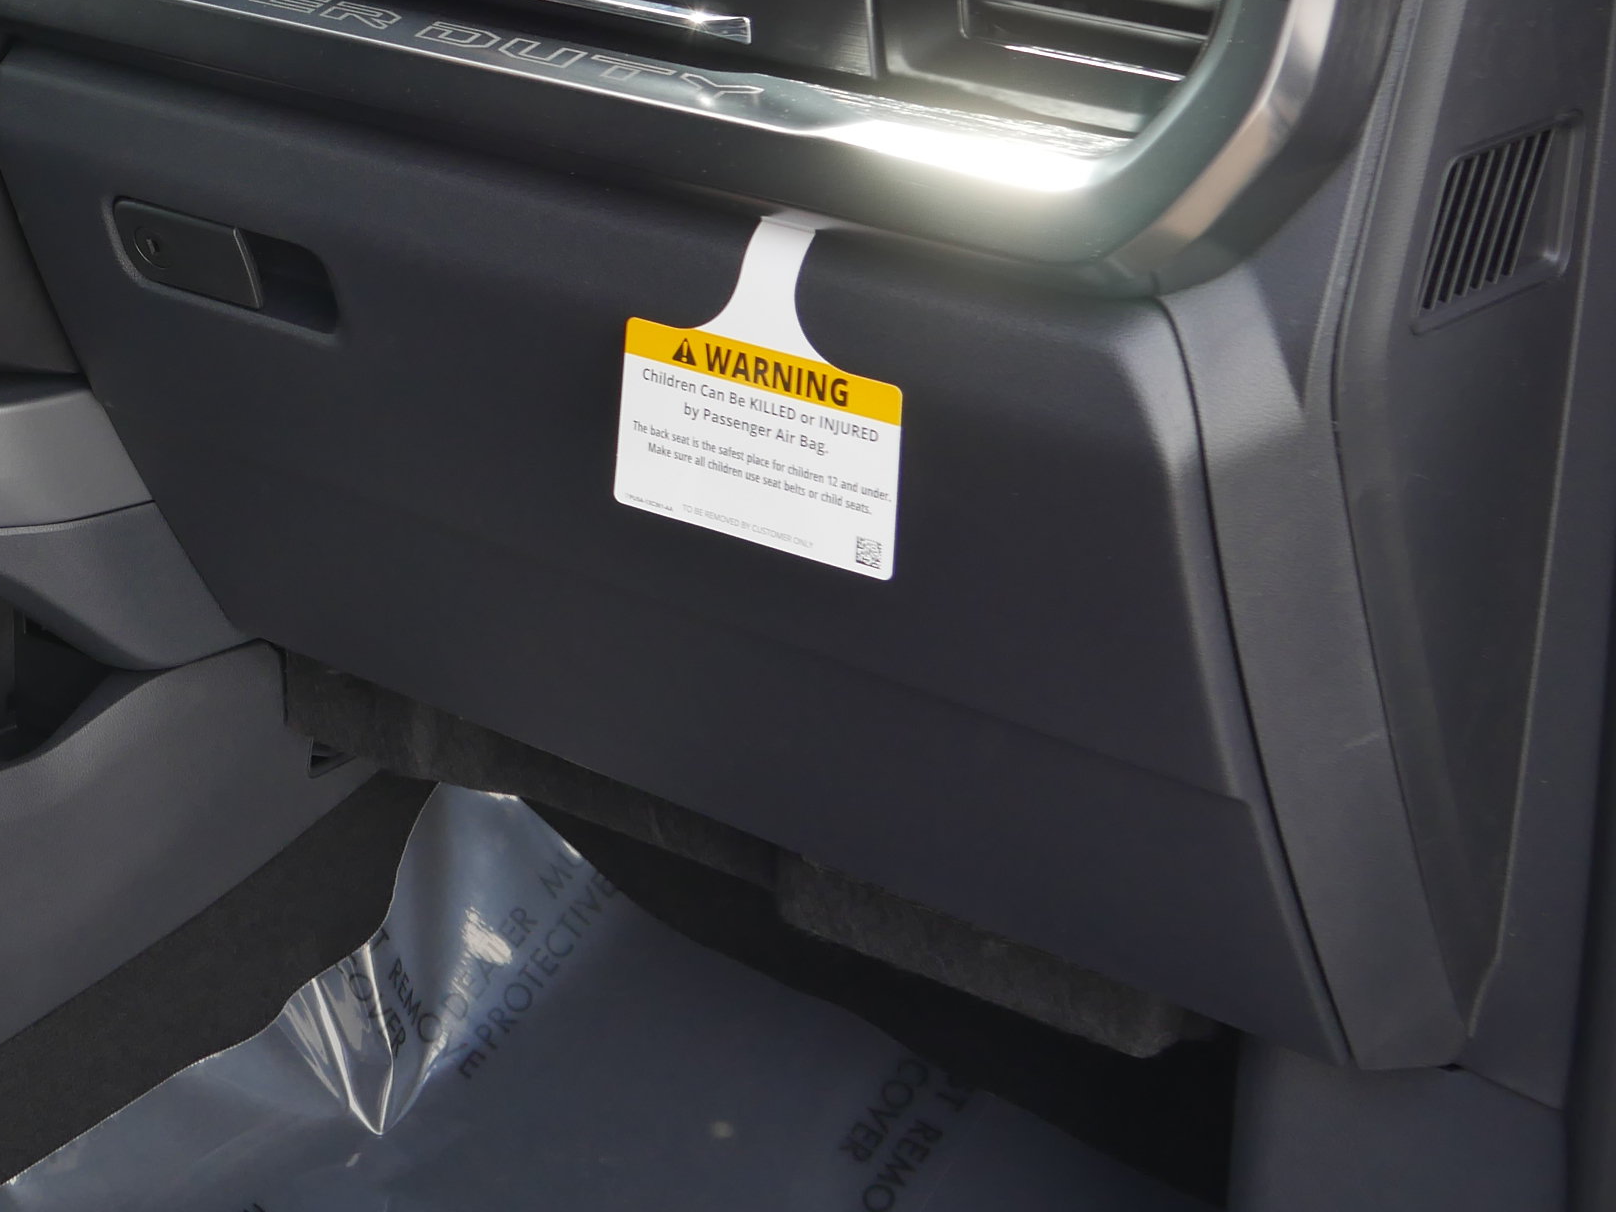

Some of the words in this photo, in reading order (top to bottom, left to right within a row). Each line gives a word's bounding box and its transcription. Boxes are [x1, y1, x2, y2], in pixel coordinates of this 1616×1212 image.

[414, 19, 765, 101] DUTY
[642, 367, 697, 394] Children
[700, 384, 725, 402] Can
[729, 391, 746, 407] Be
[749, 396, 796, 421] KILLED
[800, 413, 815, 425] or
[819, 415, 880, 443] INJURED
[705, 342, 849, 407] WARNING
[633, 420, 648, 434] The
[650, 425, 670, 440] back
[672, 433, 690, 446] seat
[692, 436, 700, 448] is
[701, 440, 717, 453] the
[718, 445, 745, 461] safest
[746, 453, 771, 468] place
[772, 459, 786, 472] for
[787, 463, 825, 485] children
[827, 475, 838, 488] 12
[840, 480, 859, 493] and
[861, 485, 893, 503] under.
[684, 402, 700, 421] by
[703, 408, 773, 438] Passenger
[775, 428, 796, 444] Air
[800, 434, 830, 457] Bag.
[648, 442, 672, 457] Make
[674, 450, 693, 464] sure
[694, 456, 706, 467] all
[707, 459, 744, 478] children
[745, 471, 761, 484] use
[763, 476, 782, 490] seat
[784, 480, 806, 496] belts
[808, 489, 819, 499] or
[820, 491, 844, 508] child
[845, 499, 873, 516] seats.
[839, 1057, 930, 1164] COVER
[862, 1118, 945, 1212] REMO
